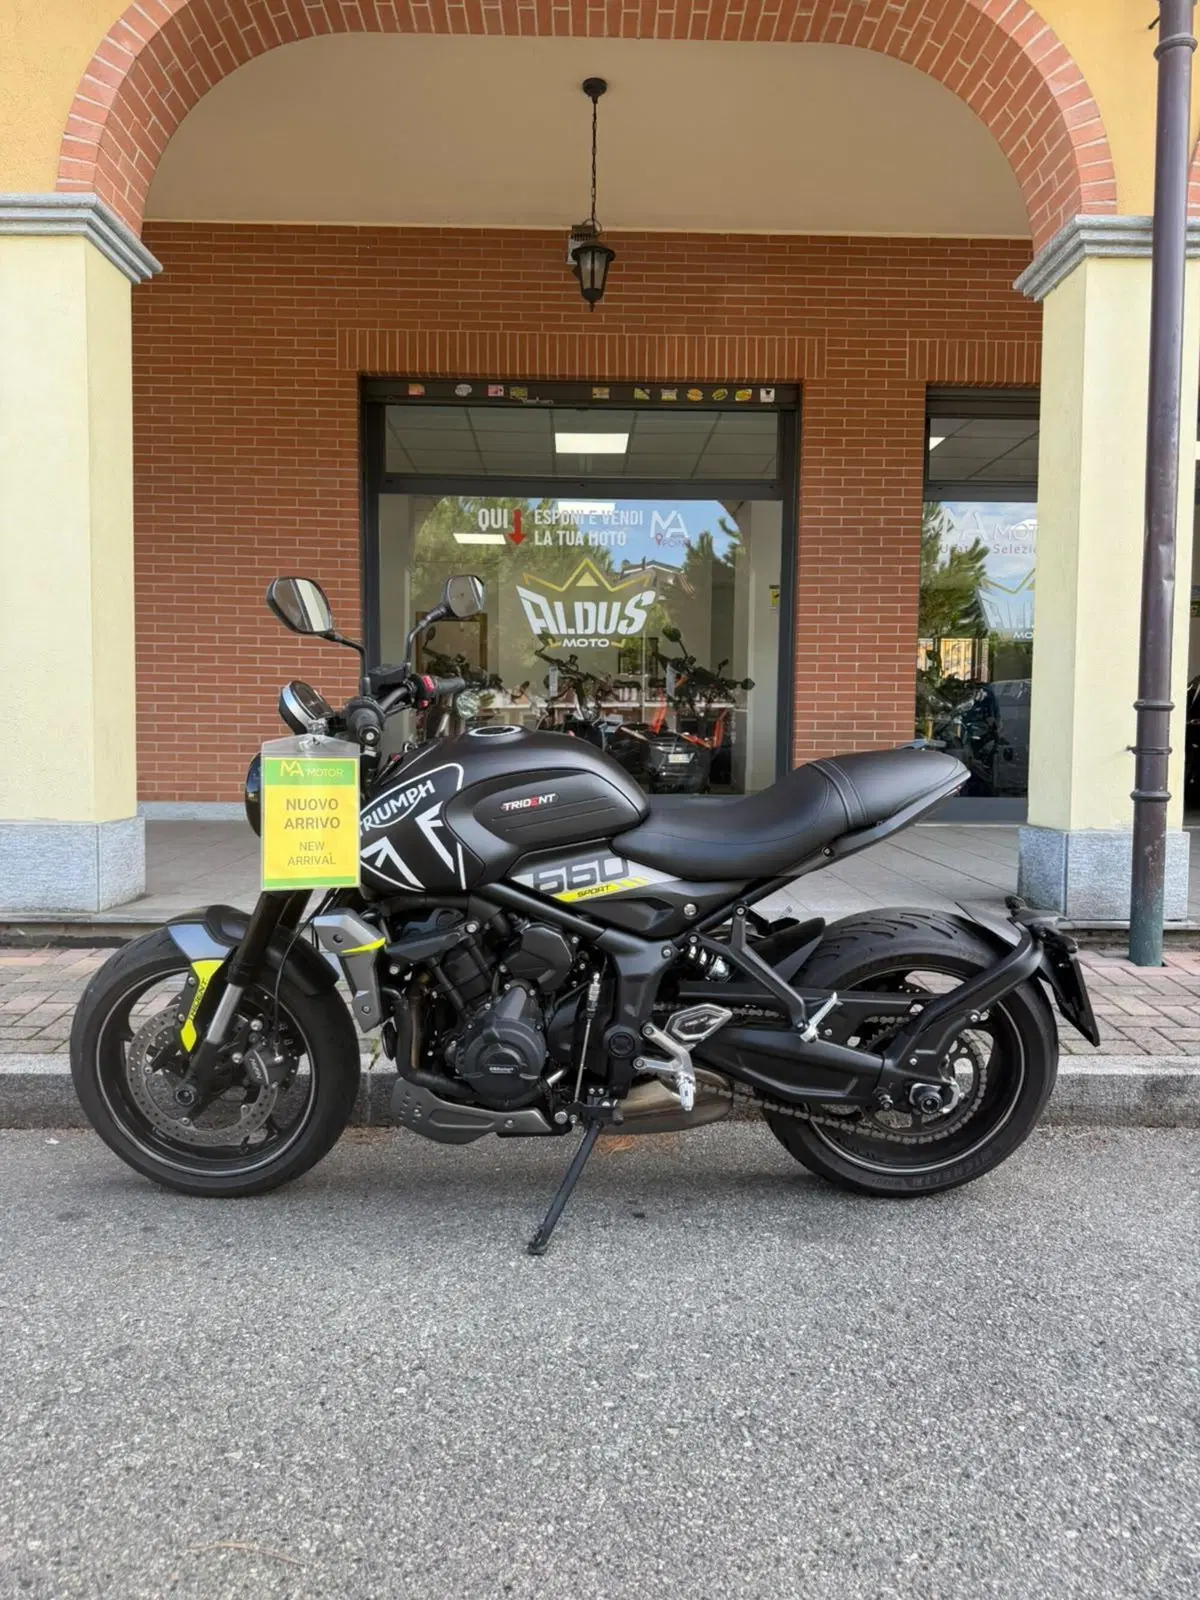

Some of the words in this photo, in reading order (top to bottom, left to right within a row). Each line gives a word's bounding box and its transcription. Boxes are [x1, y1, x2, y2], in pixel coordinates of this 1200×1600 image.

[478, 508, 508, 531] QUI
[534, 510, 584, 525] ESPONI
[589, 510, 597, 525] E
[602, 510, 643, 525] VENDI
[650, 510, 689, 538] MA
[534, 531, 553, 546] LA
[556, 531, 584, 546] TUA
[588, 531, 626, 546] MOTO
[516, 584, 656, 635] ALDUS
[562, 638, 610, 648] MOTO
[280, 760, 305, 778] MA
[307, 768, 344, 778] MOTOR
[285, 798, 339, 811] NUOVO
[501, 793, 556, 812] TRIDENT
[284, 816, 341, 831] ARRIVO
[299, 841, 325, 852] NEW
[287, 854, 337, 867] ARRIVAL
[532, 856, 629, 894] 660
[577, 884, 610, 898] SPORT
